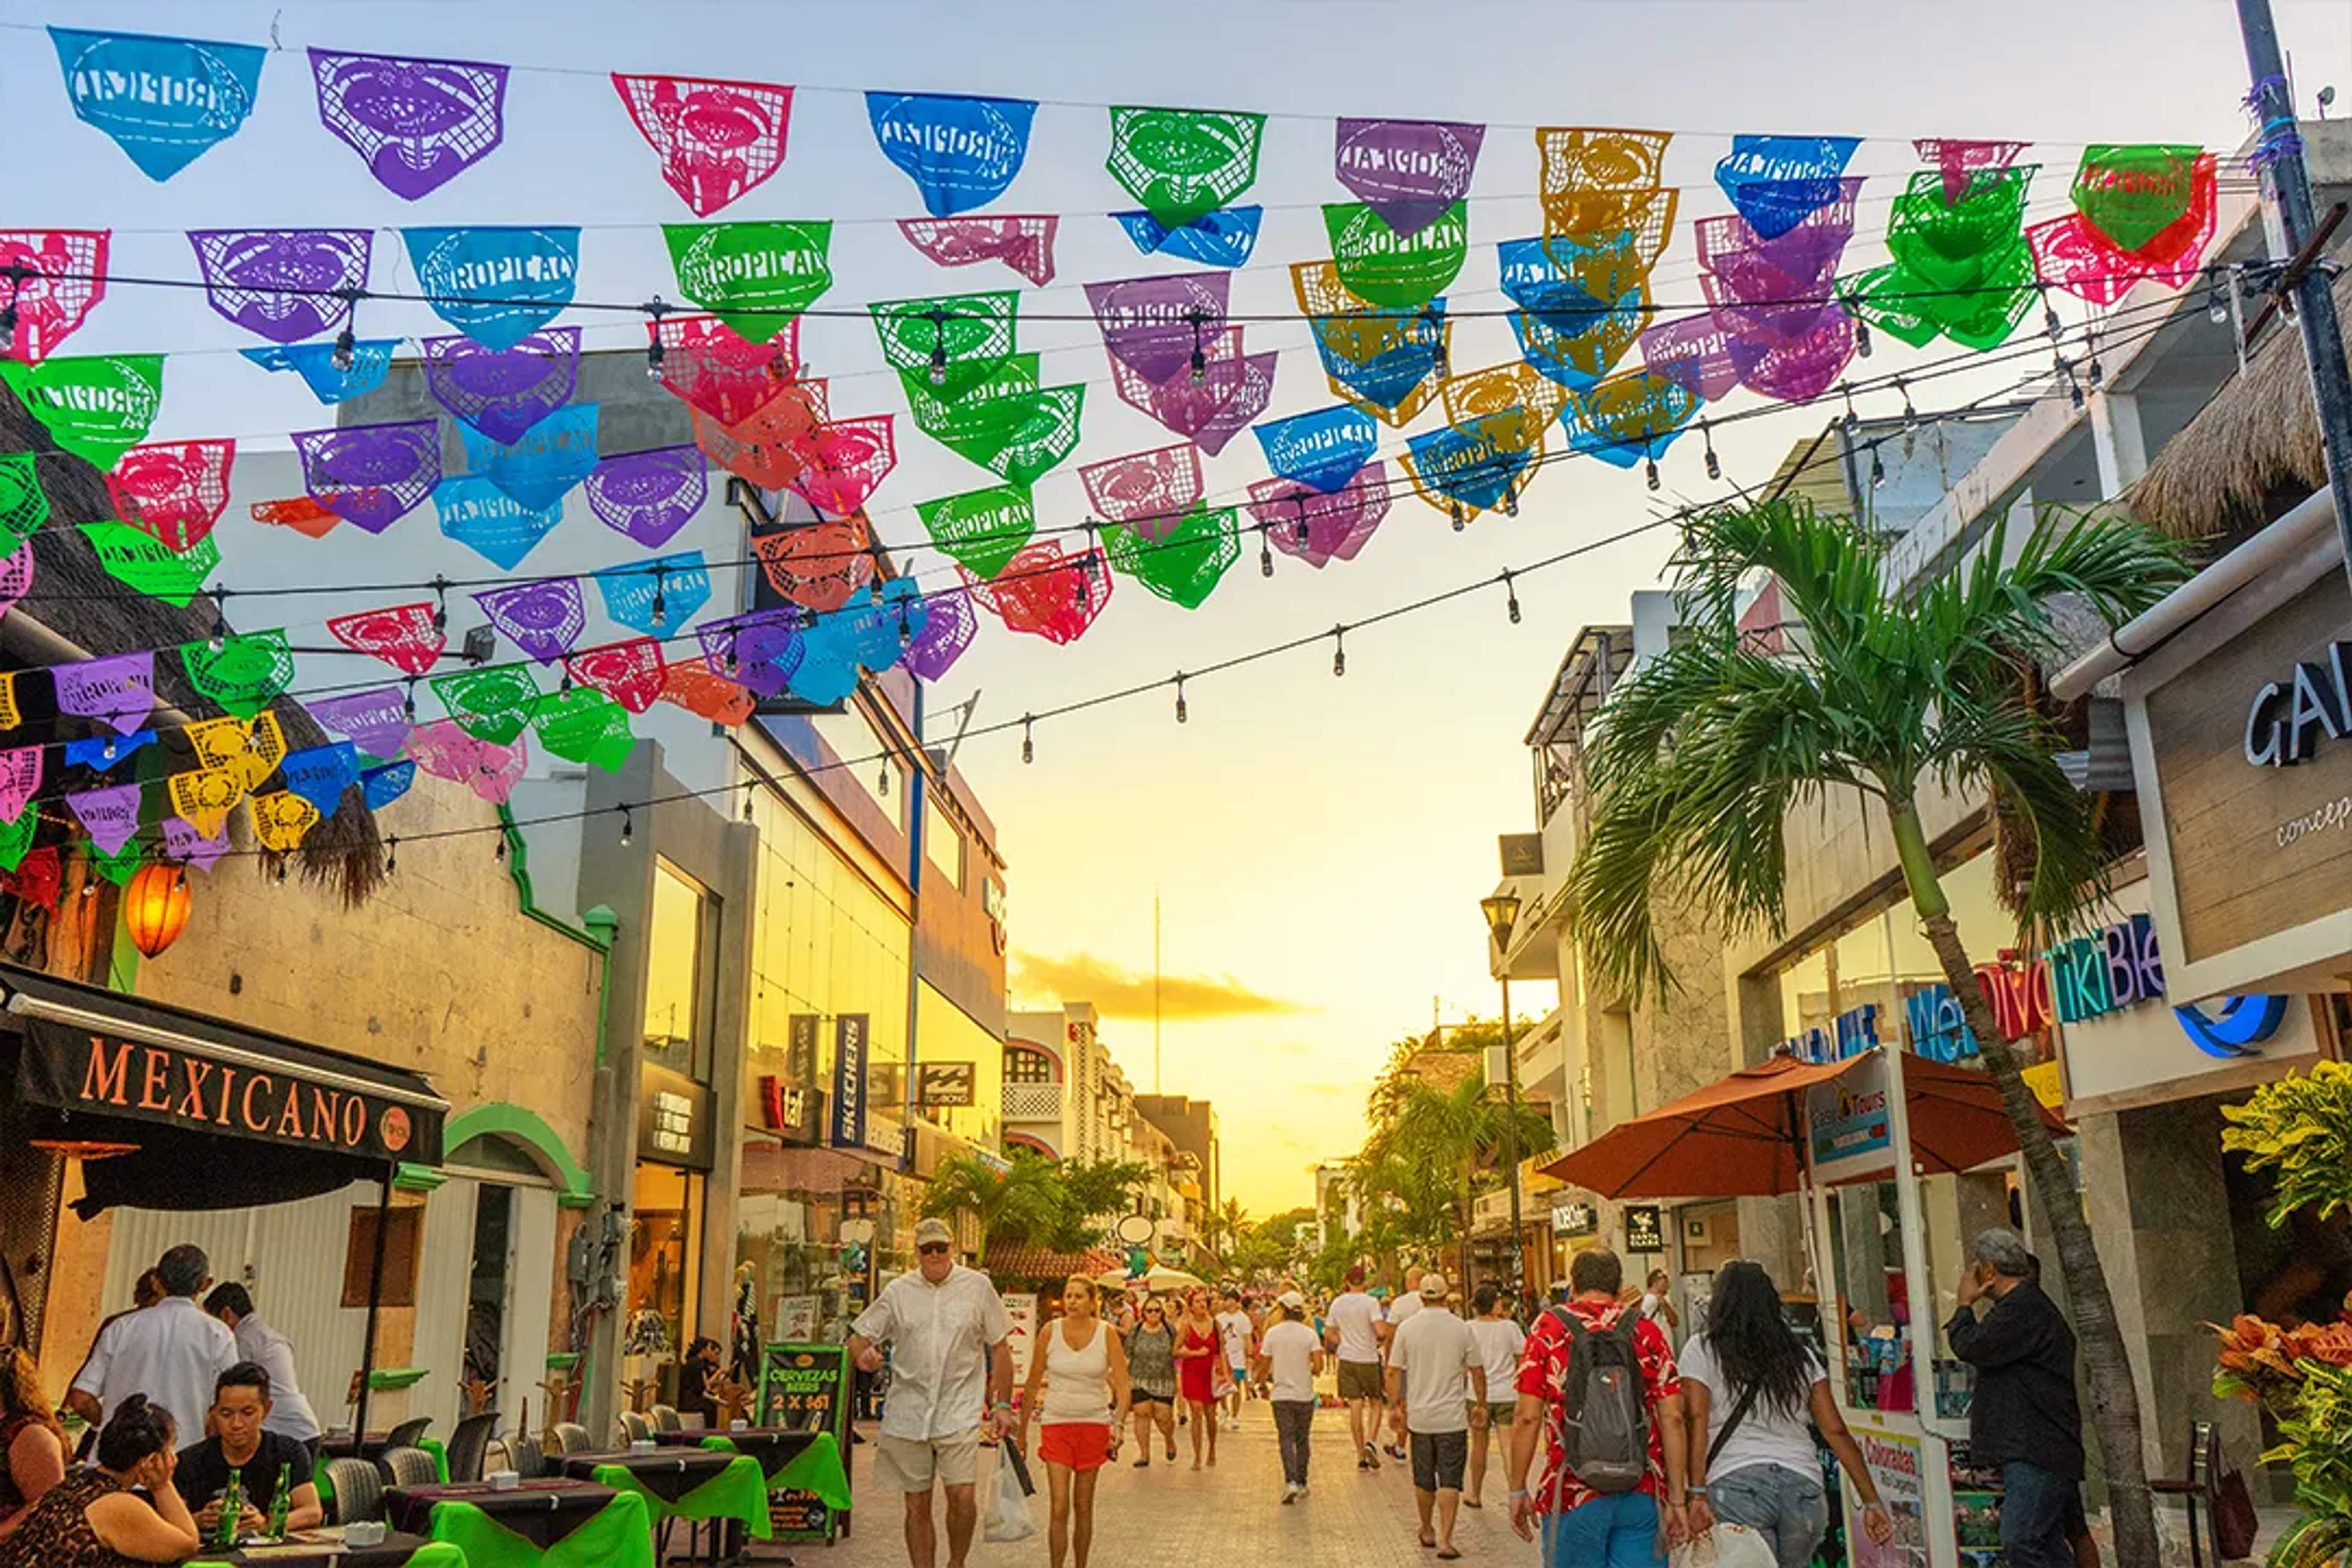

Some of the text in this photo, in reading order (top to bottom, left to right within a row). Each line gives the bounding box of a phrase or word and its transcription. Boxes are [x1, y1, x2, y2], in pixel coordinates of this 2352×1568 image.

[80, 1036, 368, 1147] MEXICANO
[842, 1019, 859, 1142] SKECHERS
[770, 1369, 838, 1382] CERVEZAS
[772, 1394, 785, 1410] 2
